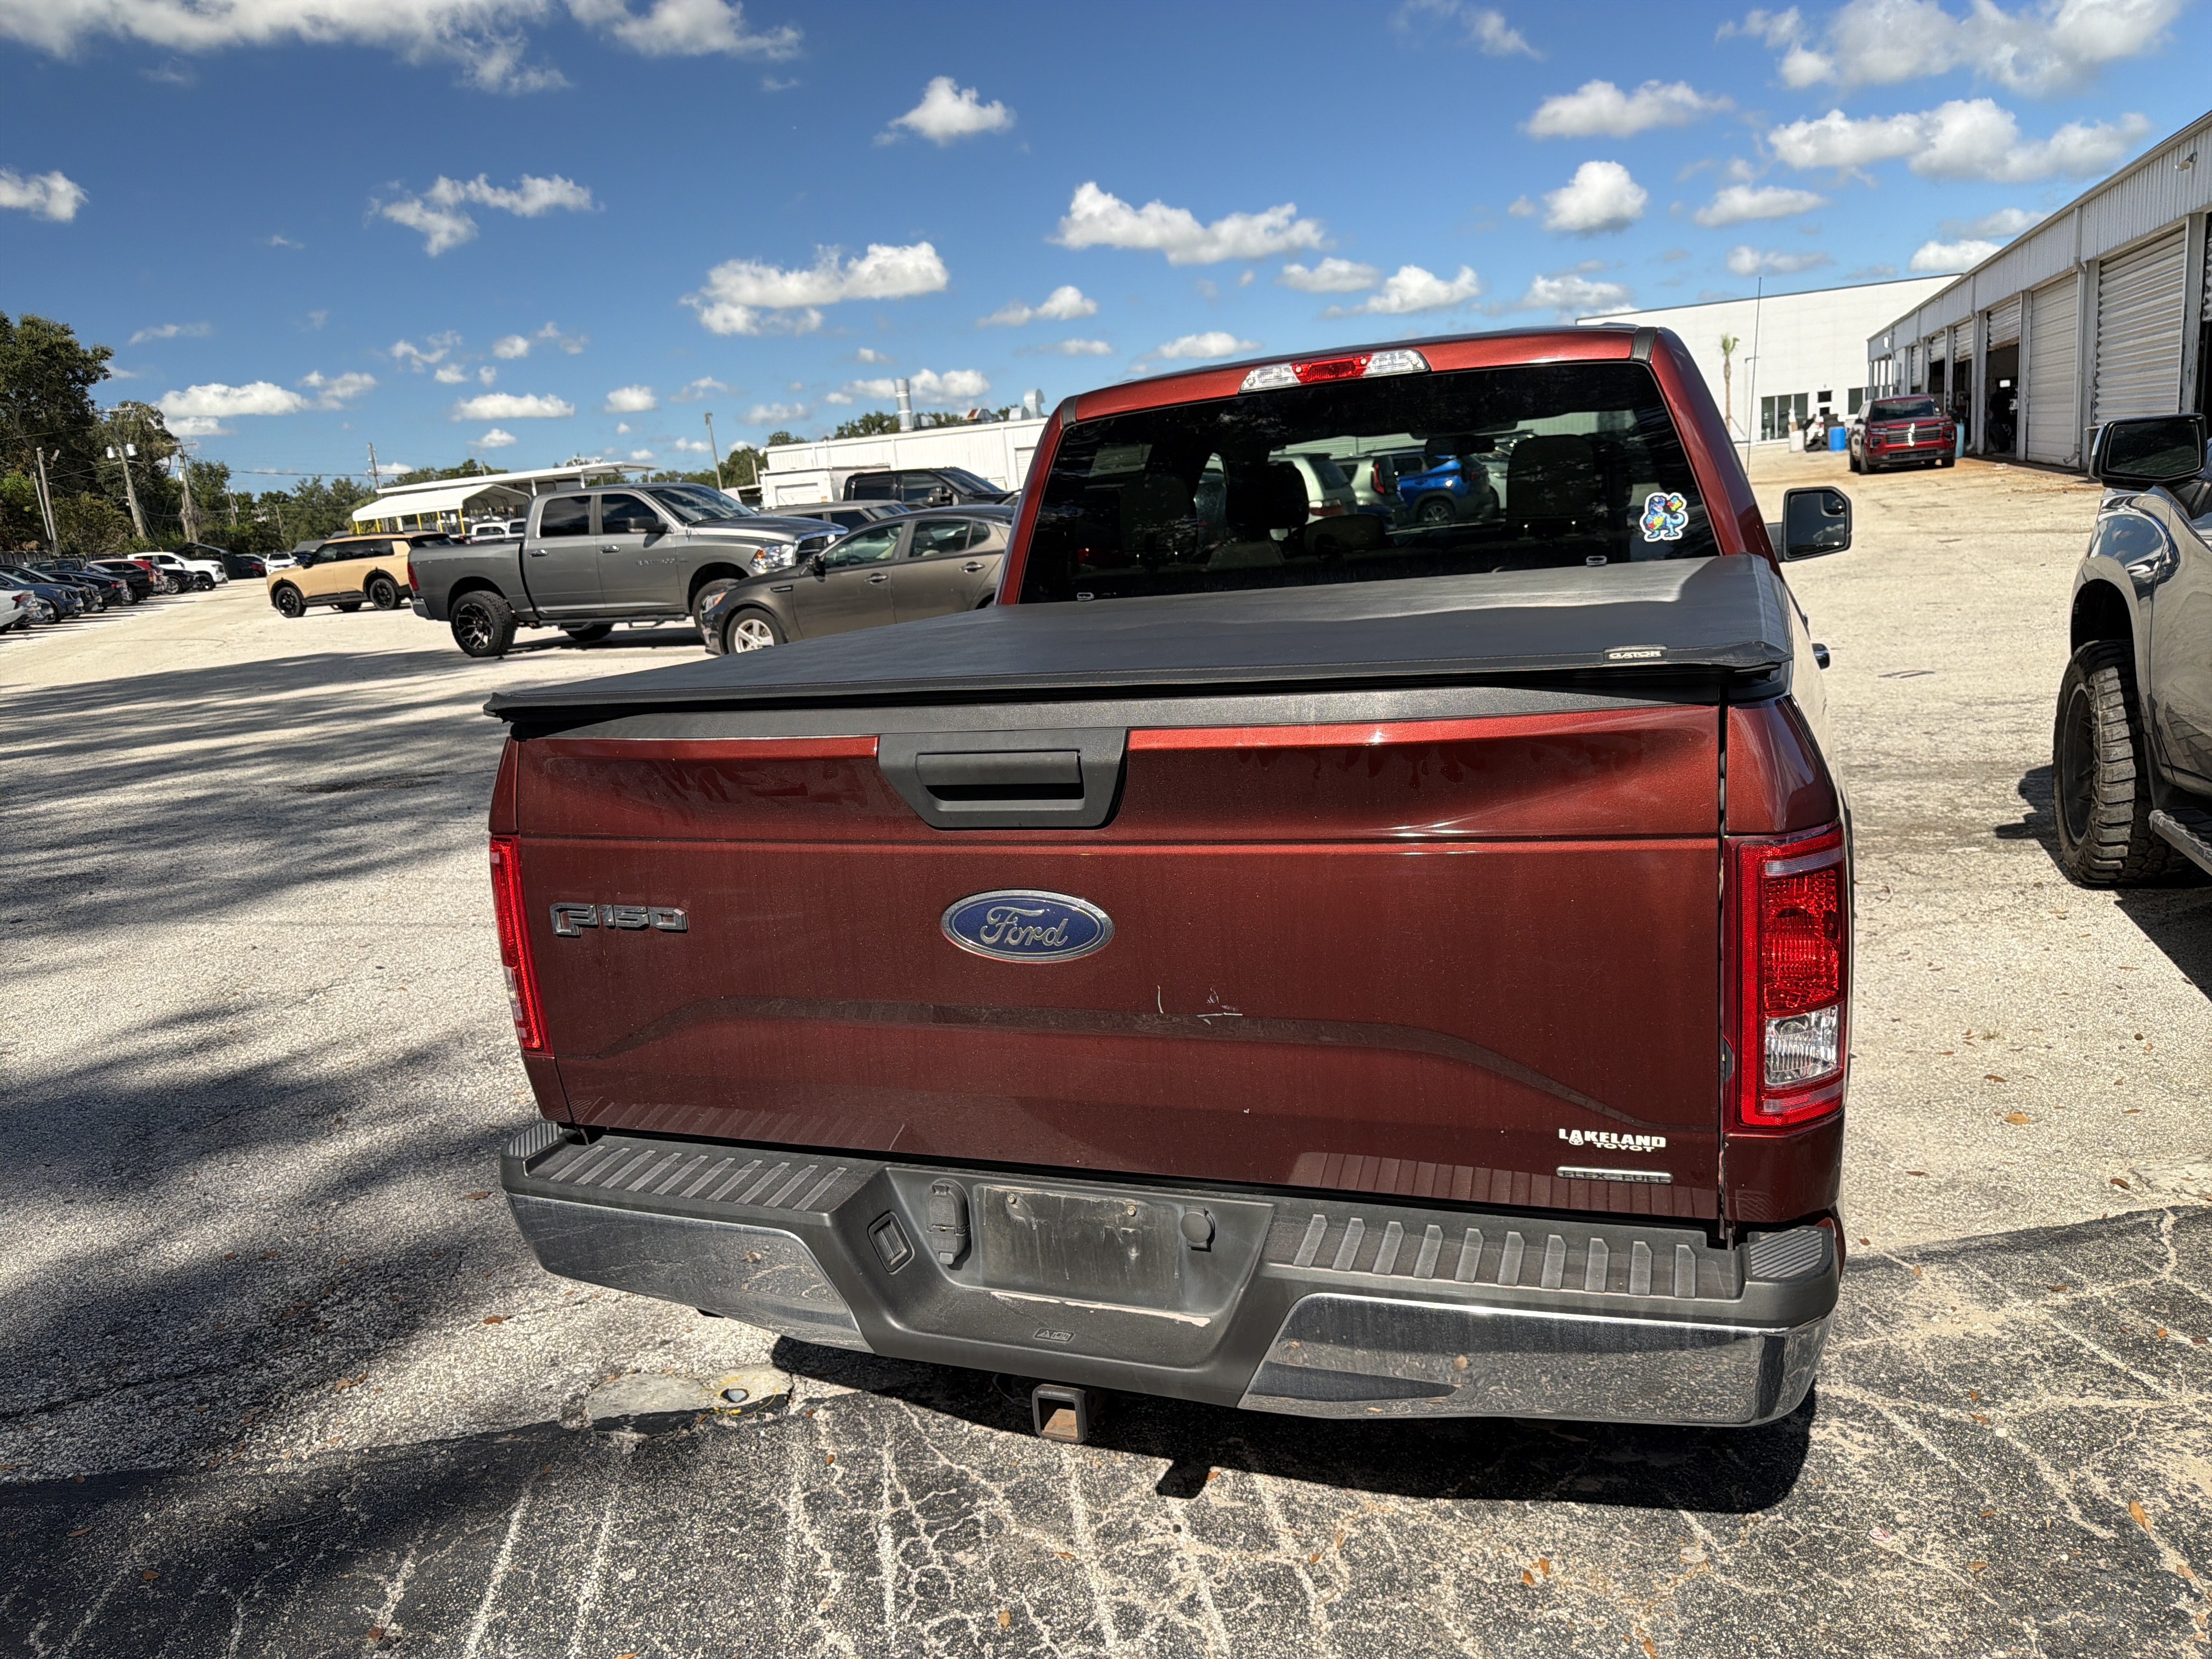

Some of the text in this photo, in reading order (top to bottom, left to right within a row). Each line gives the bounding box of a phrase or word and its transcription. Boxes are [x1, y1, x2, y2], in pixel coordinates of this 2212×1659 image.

[1609, 651, 1662, 659] GATOR
[980, 906, 1069, 946] Ford
[1559, 1128, 1666, 1148] LAKELAND
[1562, 1171, 1668, 1183] FLEX FUEL
